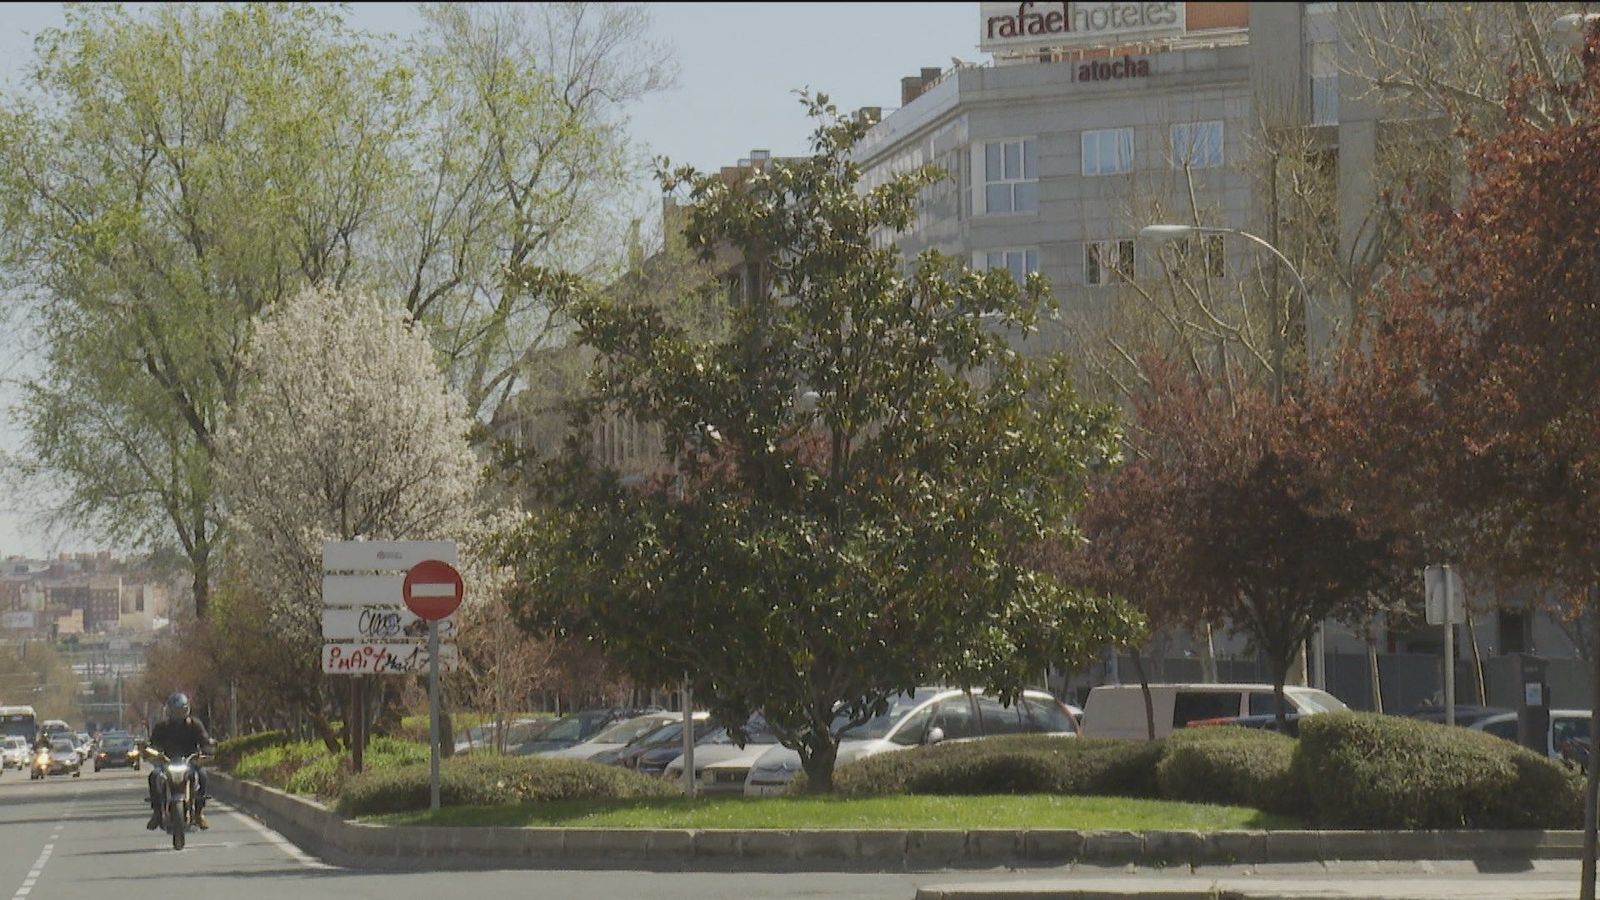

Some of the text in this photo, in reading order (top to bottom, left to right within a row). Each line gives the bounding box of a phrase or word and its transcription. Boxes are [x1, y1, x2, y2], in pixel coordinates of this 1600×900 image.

[987, 2, 1177, 39] rafael hoteles
[1078, 55, 1150, 83] atocha
